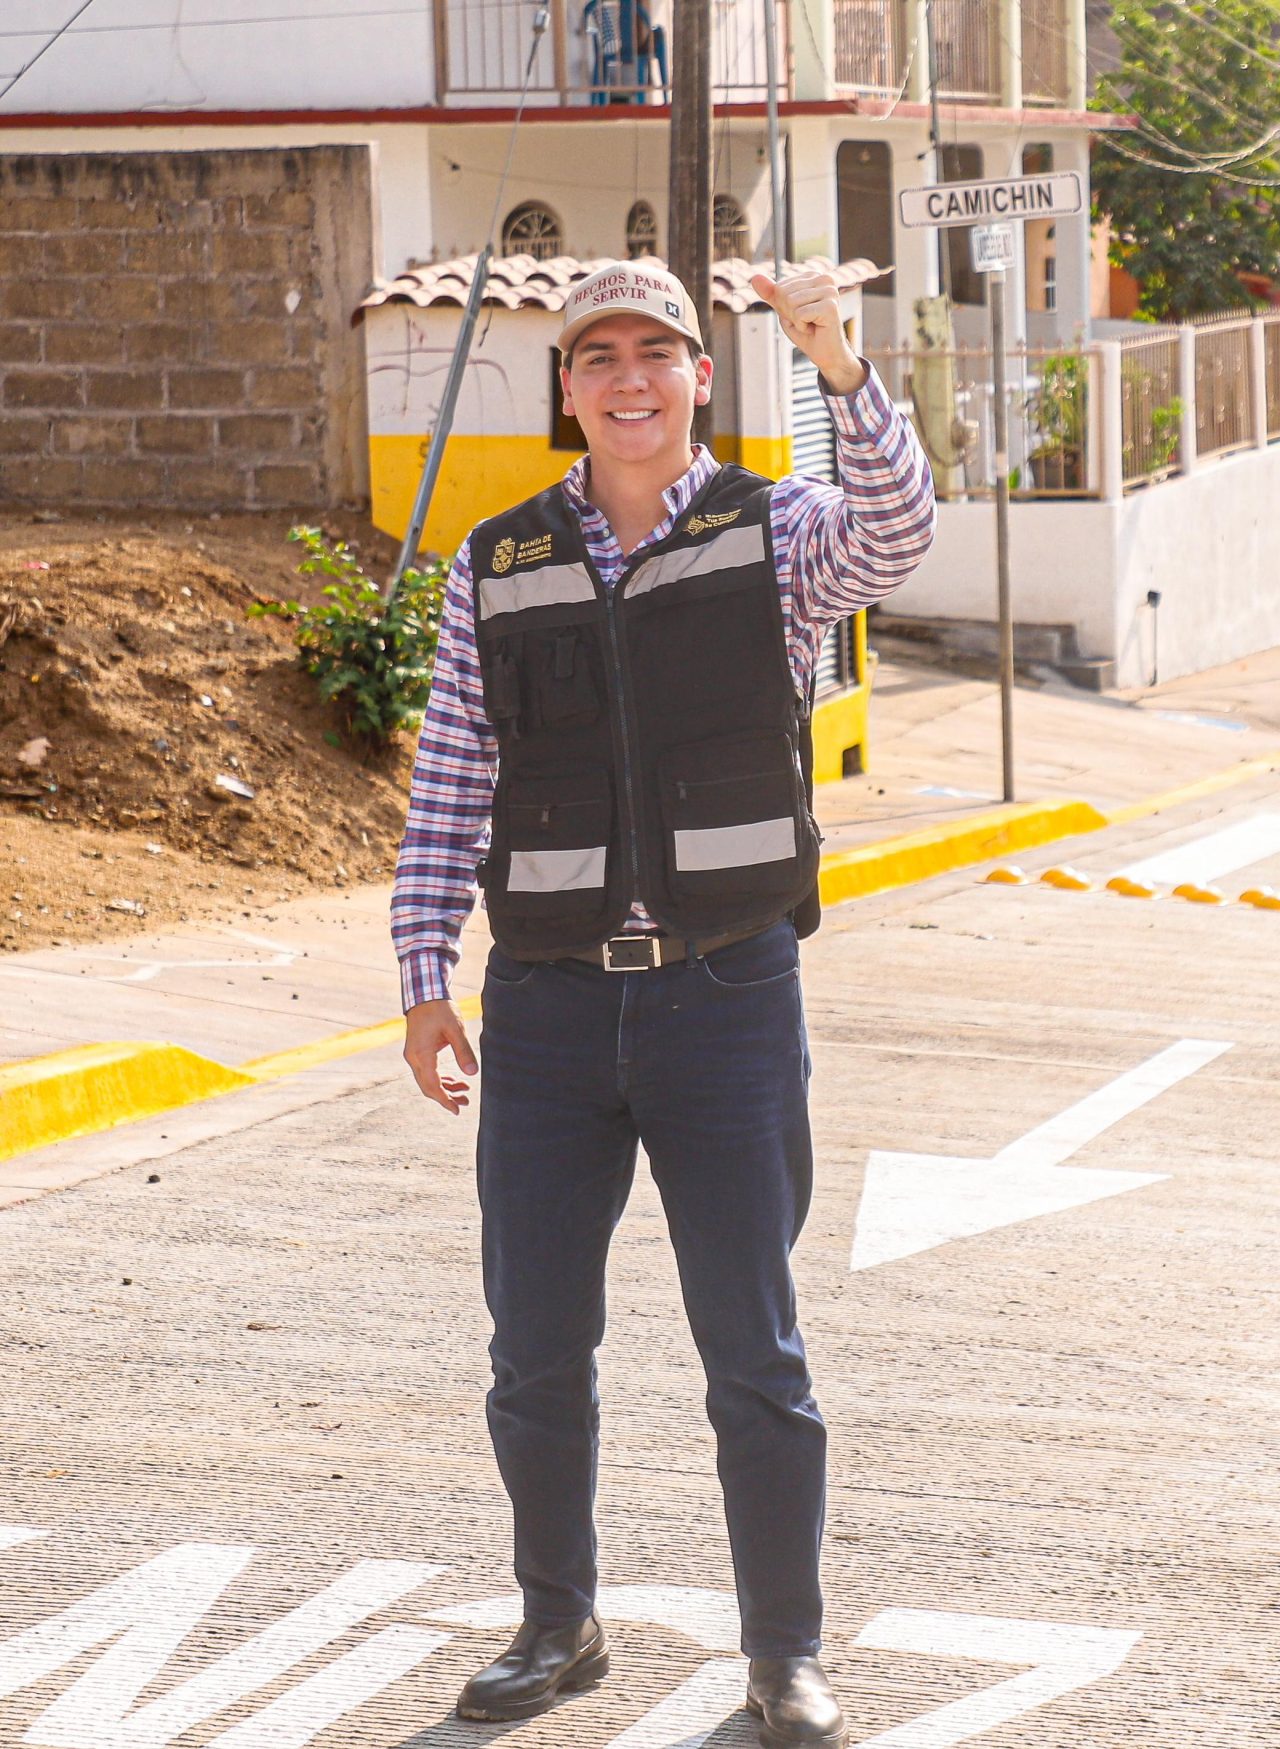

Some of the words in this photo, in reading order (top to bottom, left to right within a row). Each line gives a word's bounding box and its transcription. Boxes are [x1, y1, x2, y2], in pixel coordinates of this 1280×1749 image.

[927, 182, 1054, 219] CAMICHIN
[574, 273, 627, 305] HECHOS
[634, 274, 672, 294] PARA
[592, 287, 647, 307] SERVIR
[542, 534, 552, 543] DE
[517, 543, 552, 559] BANDERAS
